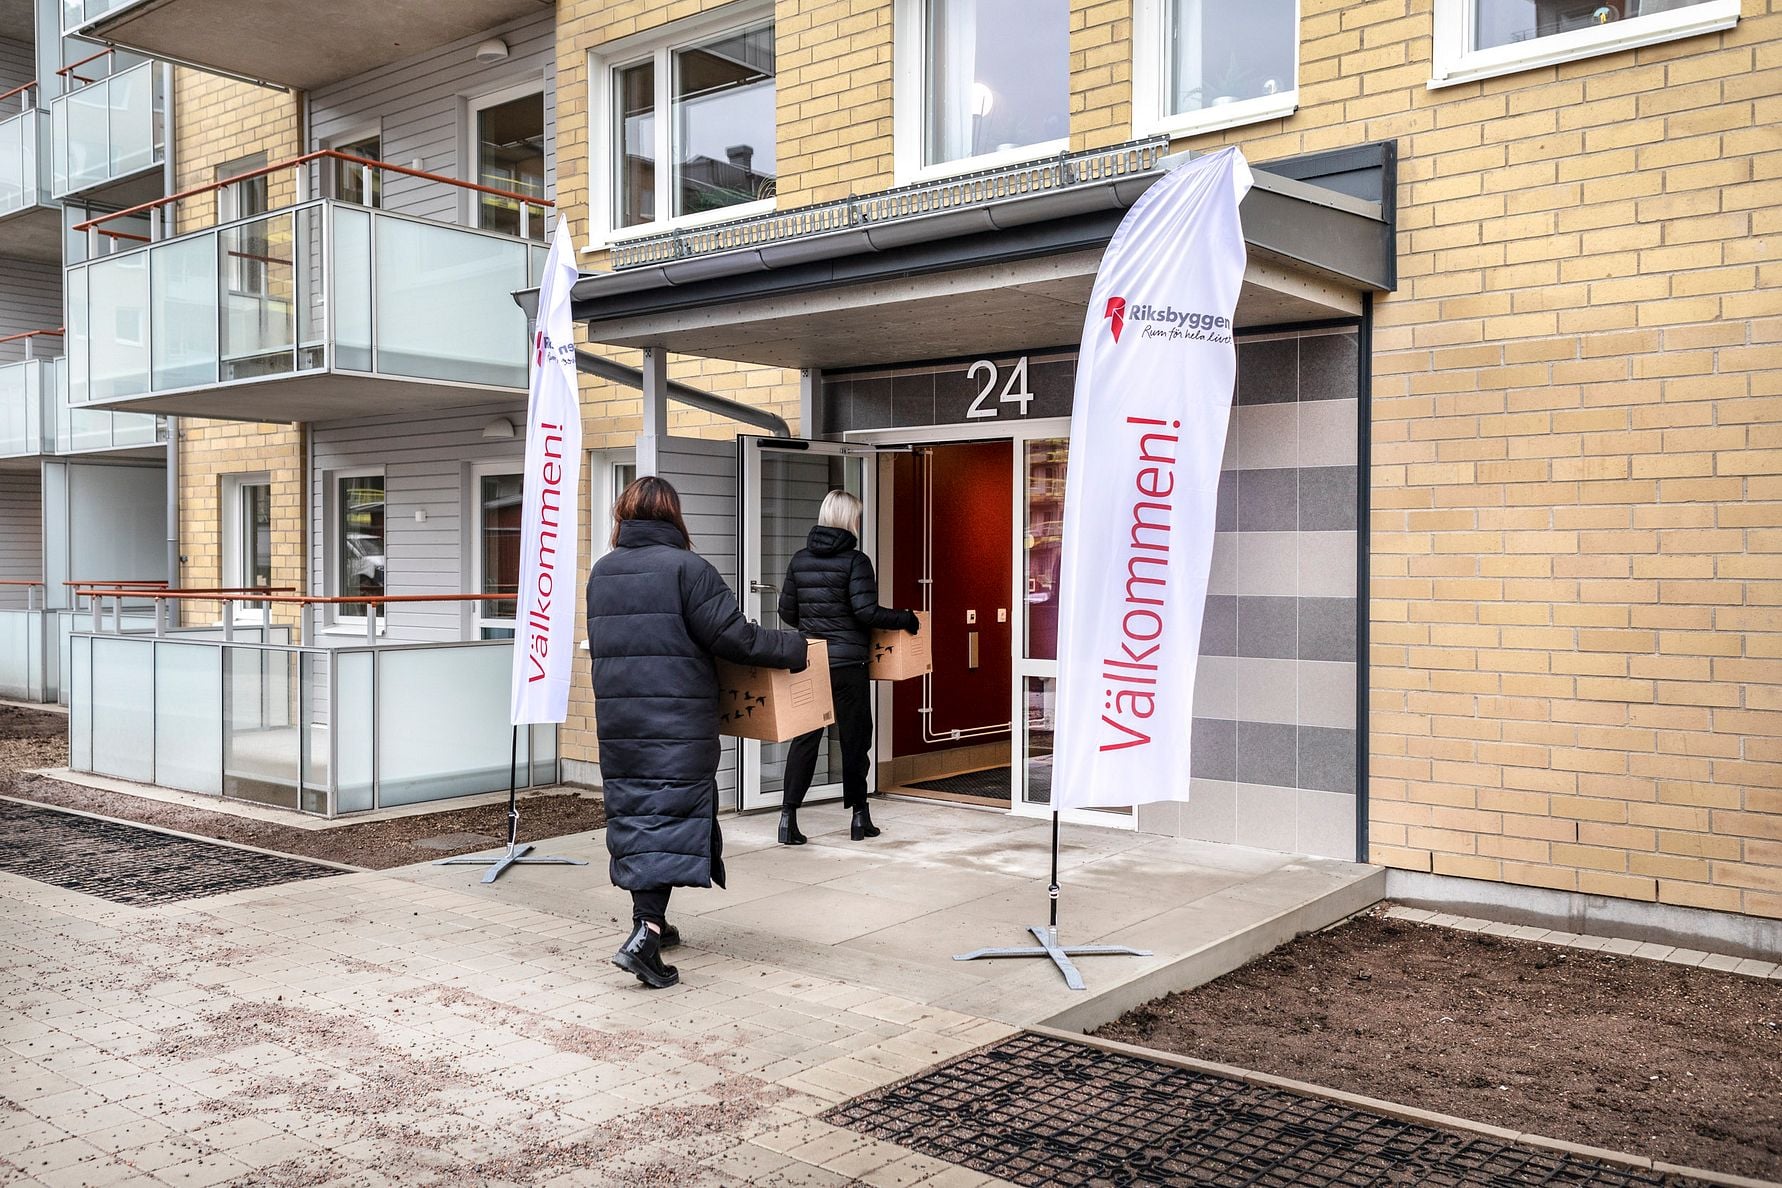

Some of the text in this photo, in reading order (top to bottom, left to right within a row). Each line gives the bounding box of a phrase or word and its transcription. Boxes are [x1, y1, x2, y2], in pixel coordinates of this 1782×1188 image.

[1129, 305, 1230, 330] Riksbyggen
[1142, 325, 1166, 338] Rum
[1169, 328, 1182, 340] för
[1185, 329, 1205, 341] hela
[967, 356, 1034, 418] 24
[528, 422, 563, 682] Välkommen!
[1099, 416, 1181, 752] Välkommen!
